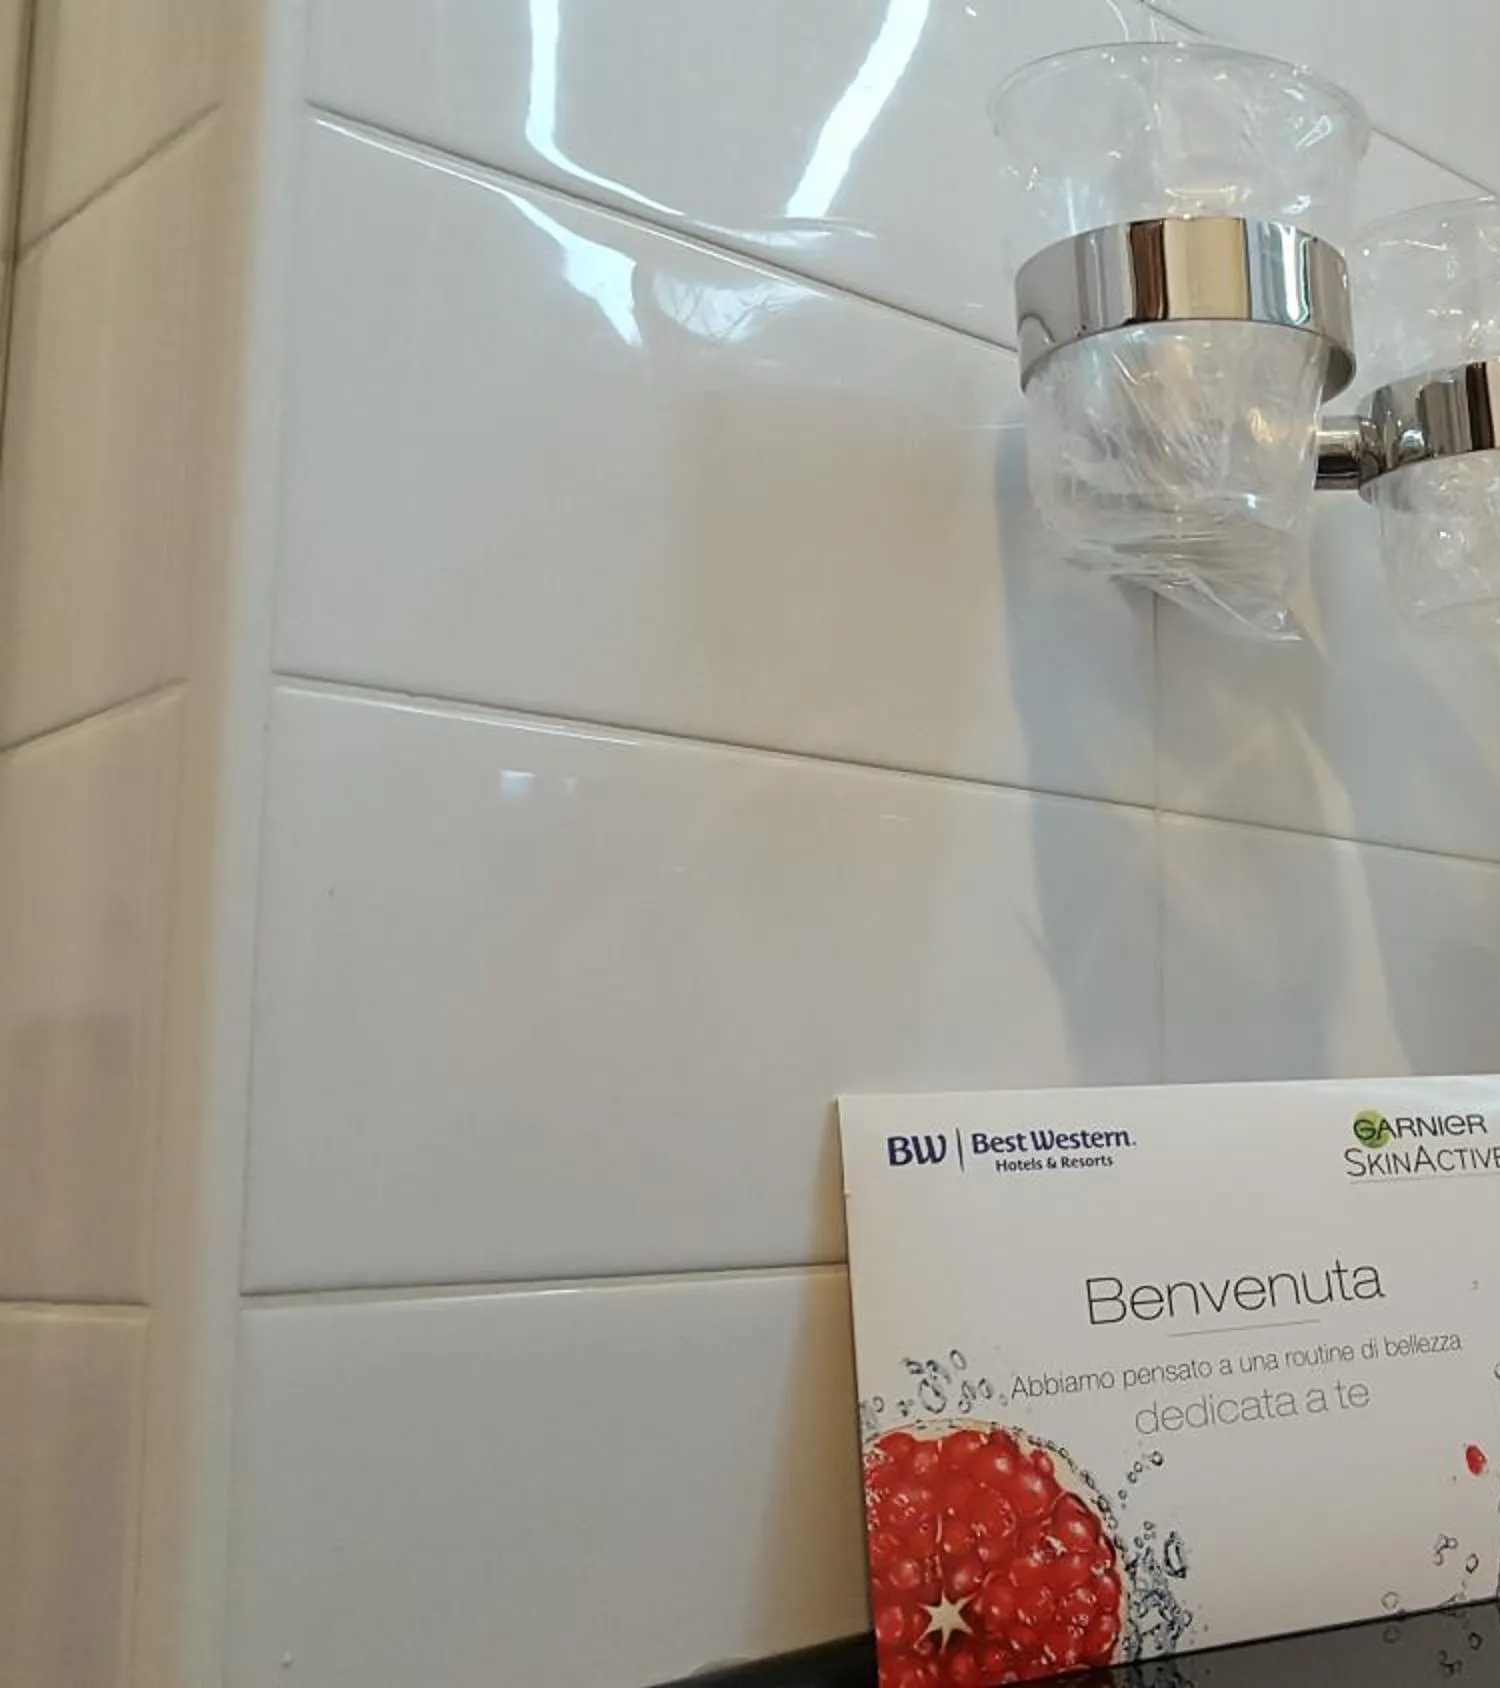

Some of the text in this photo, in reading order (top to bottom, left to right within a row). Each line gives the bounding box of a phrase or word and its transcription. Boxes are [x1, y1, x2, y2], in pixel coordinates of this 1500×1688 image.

[971, 1131, 1027, 1154] Best
[1353, 1114, 1487, 1140] GARNIER
[887, 1134, 947, 1167] BW
[995, 1154, 1114, 1172] Hotels & Resorts
[1085, 1259, 1386, 1326] Benvenuta
[1011, 1331, 1463, 1400] Abbiamo pensato a una routine di bellezza
[1135, 1379, 1371, 1435] dedicata a te
